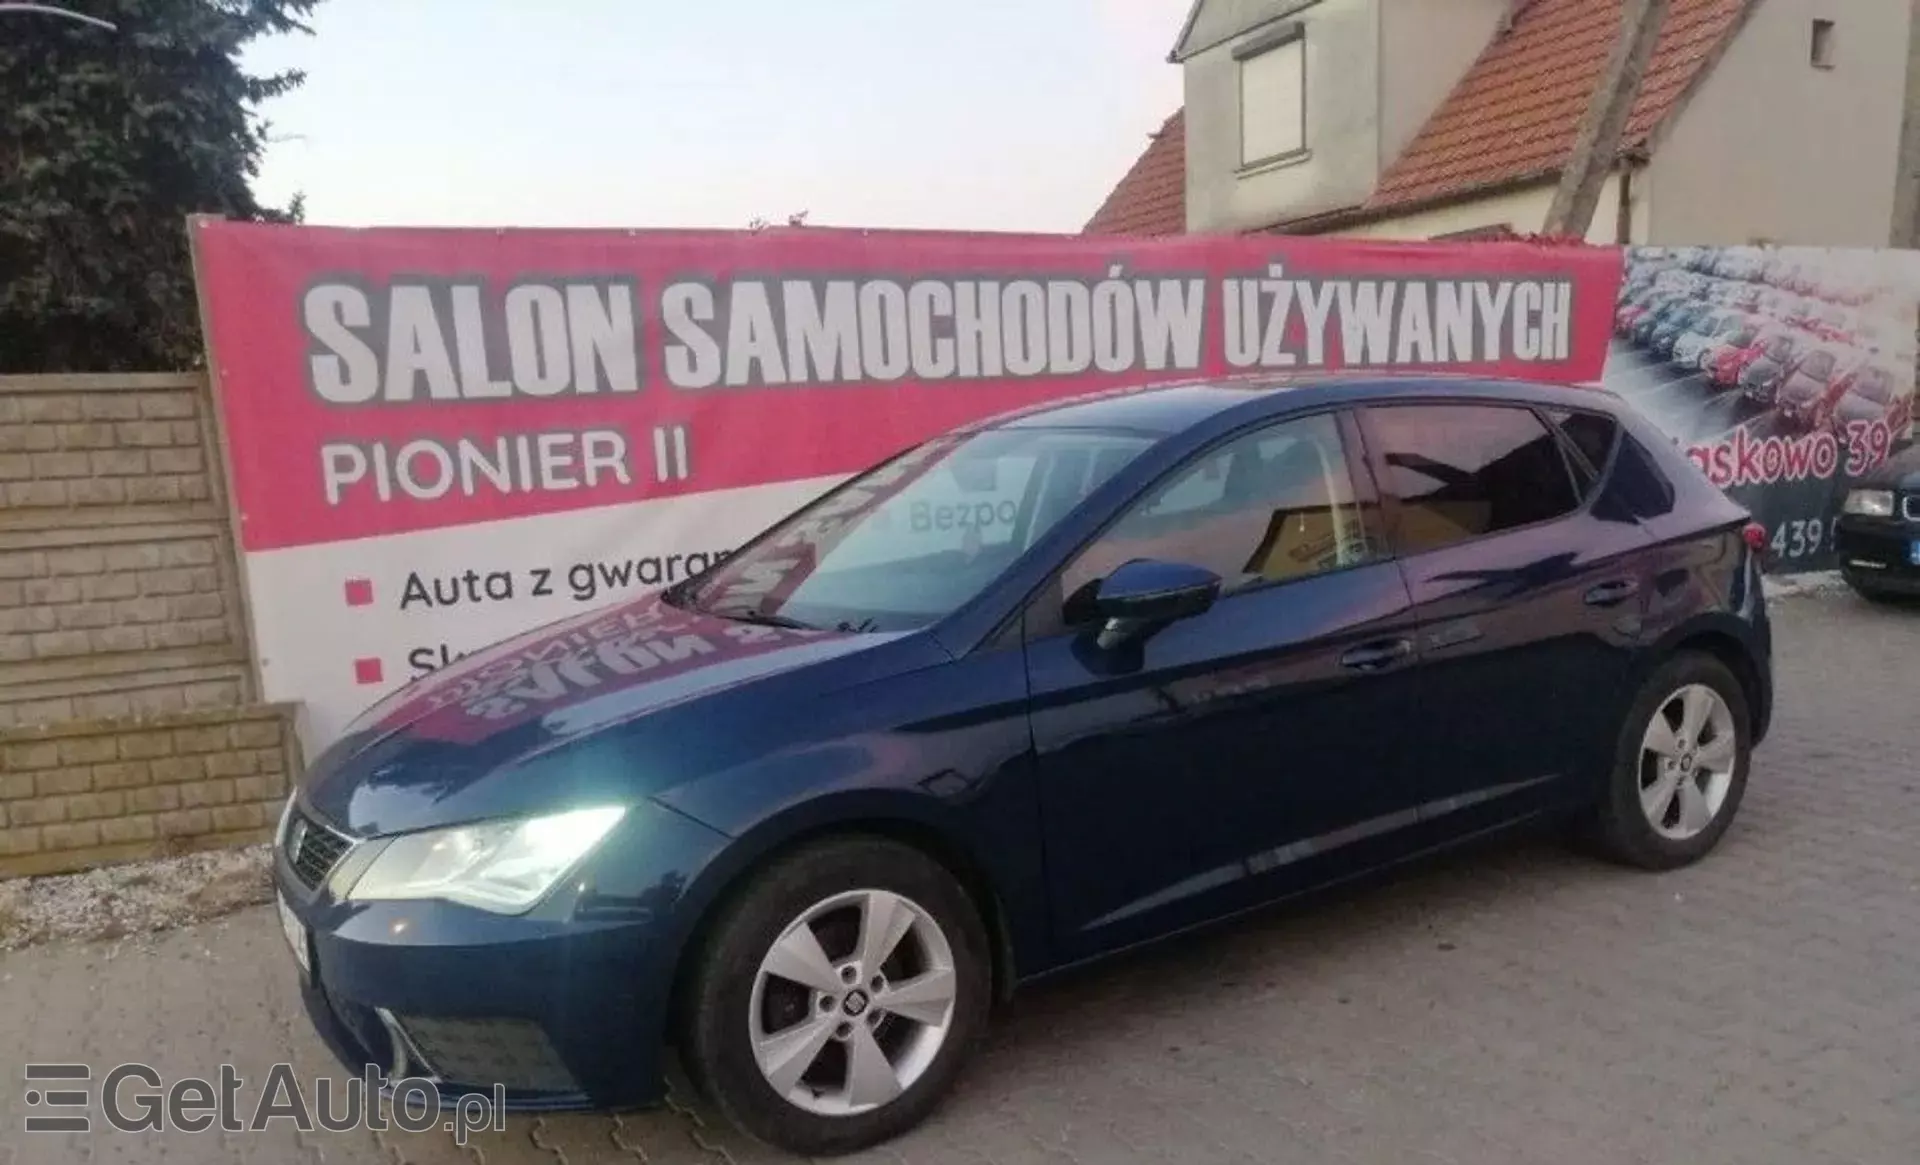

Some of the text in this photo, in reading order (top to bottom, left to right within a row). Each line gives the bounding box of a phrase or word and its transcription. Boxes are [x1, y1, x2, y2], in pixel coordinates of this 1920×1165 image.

[303, 263, 1572, 403] SALON SAMOCHODÓW UŻYWANYCH
[322, 430, 631, 506] PIONIER
[1845, 419, 1891, 476] 39
[1771, 518, 1823, 559] 439
[400, 571, 513, 610] Auta
[529, 567, 553, 597] z
